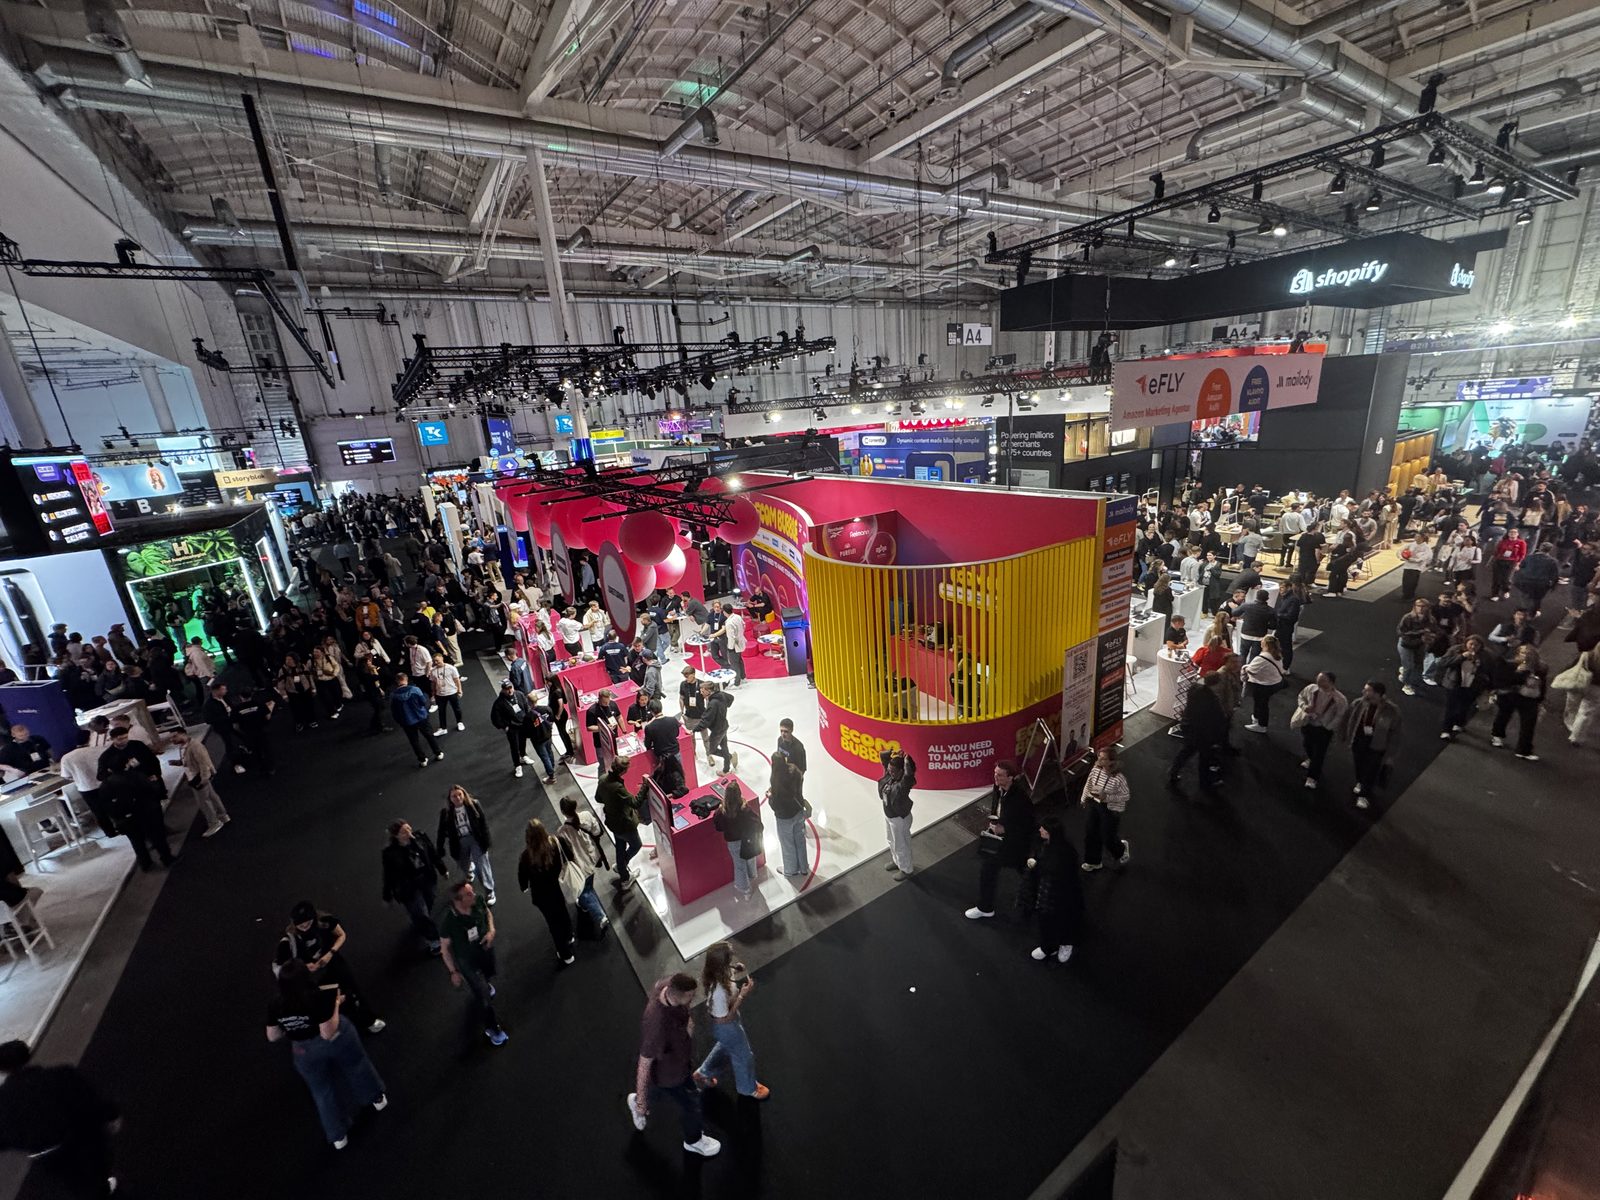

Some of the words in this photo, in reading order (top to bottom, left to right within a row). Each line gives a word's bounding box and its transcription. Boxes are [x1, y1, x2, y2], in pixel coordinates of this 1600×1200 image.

[1315, 260, 1389, 288] shopify
[965, 328, 982, 344] A4
[1230, 327, 1248, 339] A4
[1148, 372, 1185, 394] eFLY
[1122, 409, 1144, 419] Amazon
[1145, 406, 1171, 417] Marketing
[424, 426, 443, 438] TK
[1029, 431, 1055, 439] millions
[896, 437, 913, 445] Dynamic
[963, 437, 980, 445] simple
[1021, 448, 1052, 456] countries
[231, 473, 265, 482] storyblok
[777, 508, 799, 545] BUBBLE
[1113, 532, 1134, 544] eFLY
[172, 541, 190, 557] H
[1108, 637, 1123, 648] eFLY
[840, 723, 900, 752] ECOM
[840, 736, 881, 763] BUBB
[928, 744, 945, 753] ALL
[947, 743, 968, 752] YOU
[969, 740, 992, 751] NEED
[928, 753, 941, 761] TO
[943, 752, 969, 761] MAKE
[971, 747, 995, 759] YOUR
[928, 761, 961, 770] BRAND
[963, 759, 982, 768] POP
